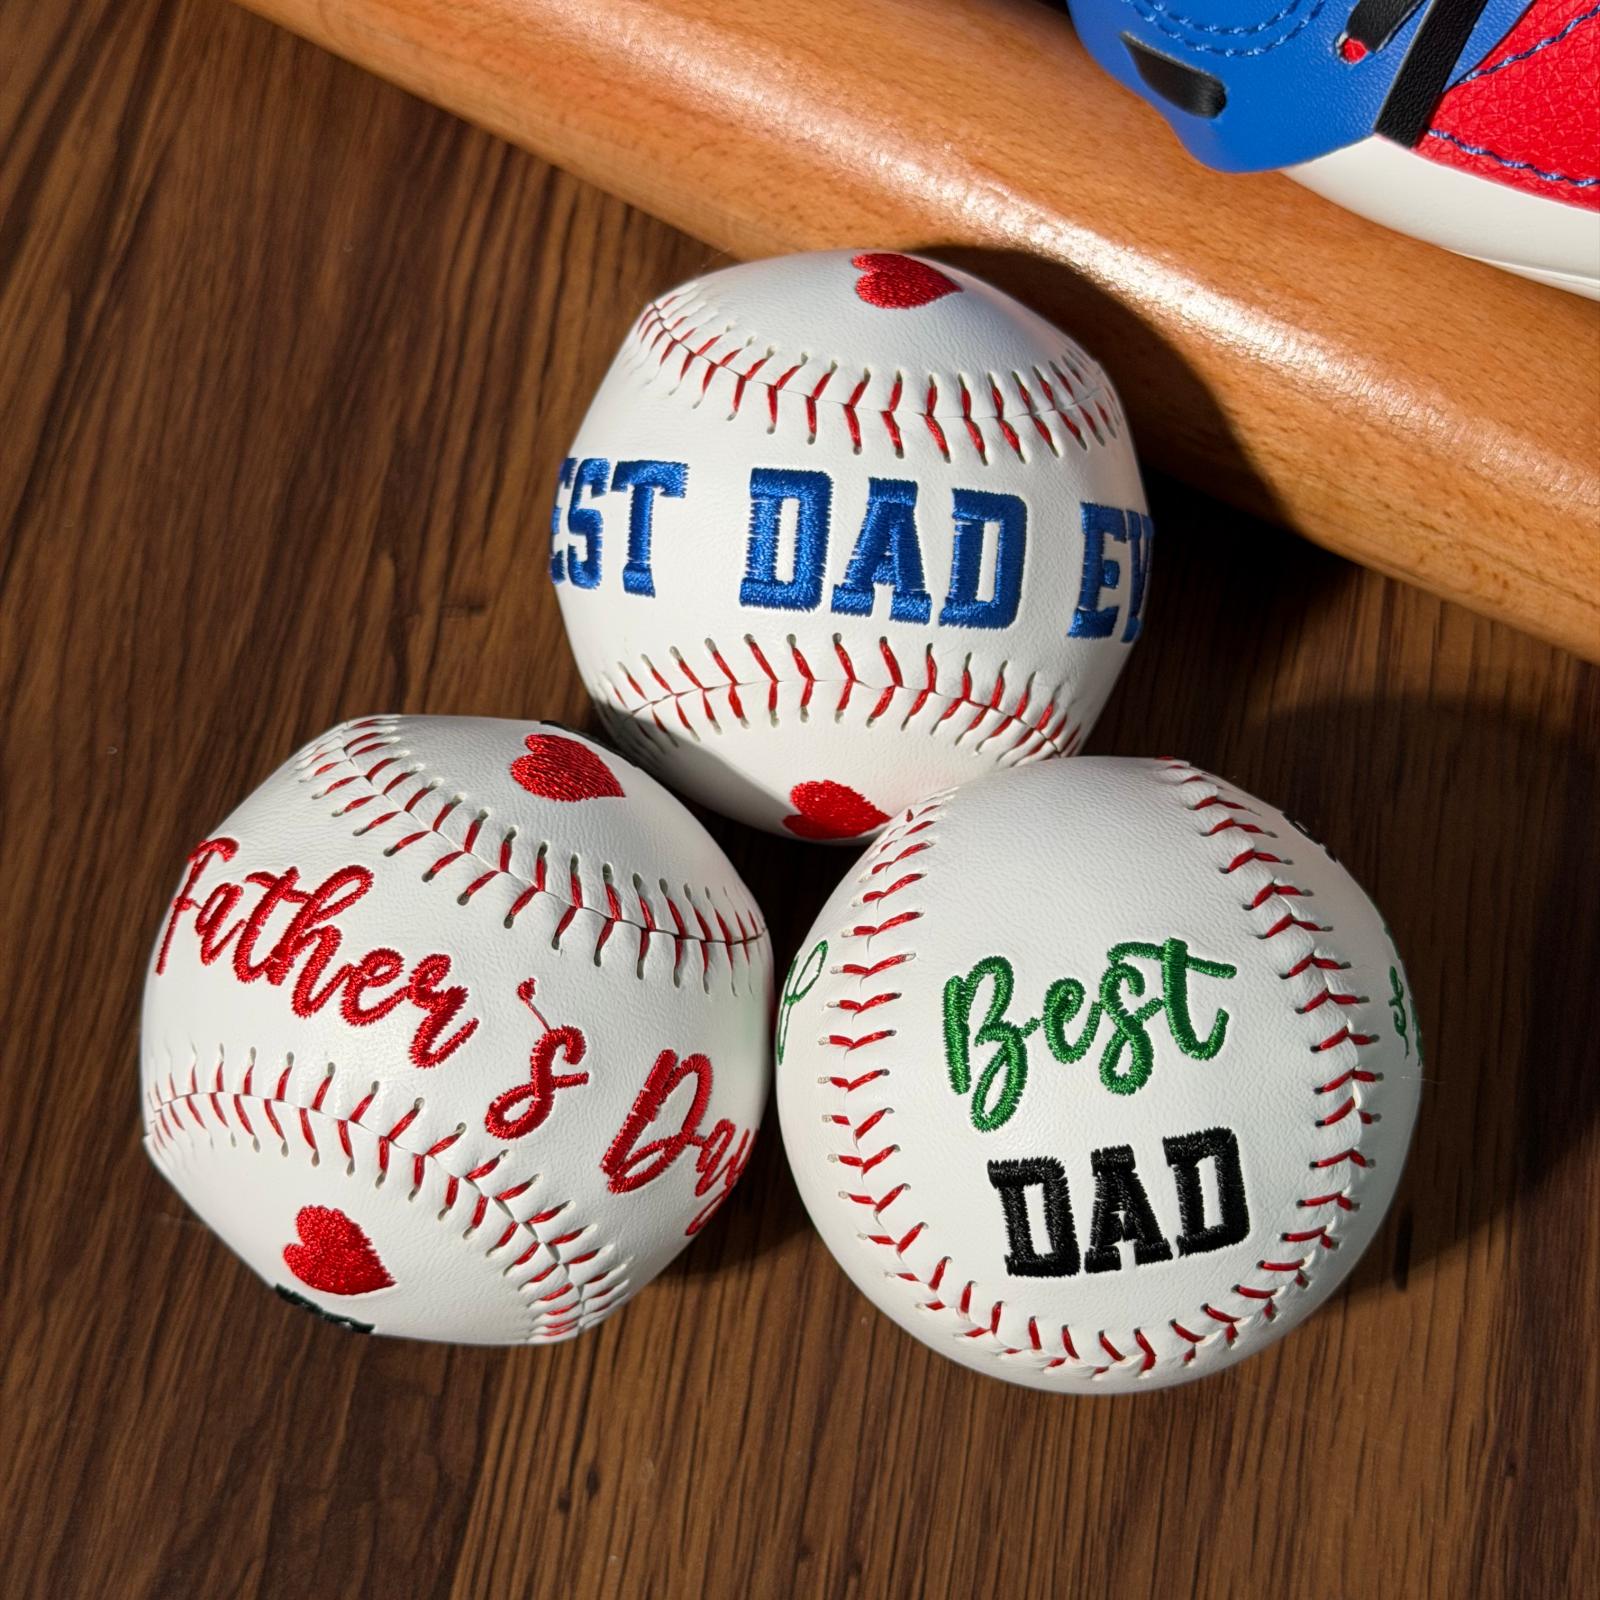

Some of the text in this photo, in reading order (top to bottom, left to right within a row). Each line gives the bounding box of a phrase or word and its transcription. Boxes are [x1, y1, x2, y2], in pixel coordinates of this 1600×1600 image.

[738, 467, 1028, 630] DAD
[942, 937, 1237, 1132] Best
[986, 1125, 1252, 1279] DAD
